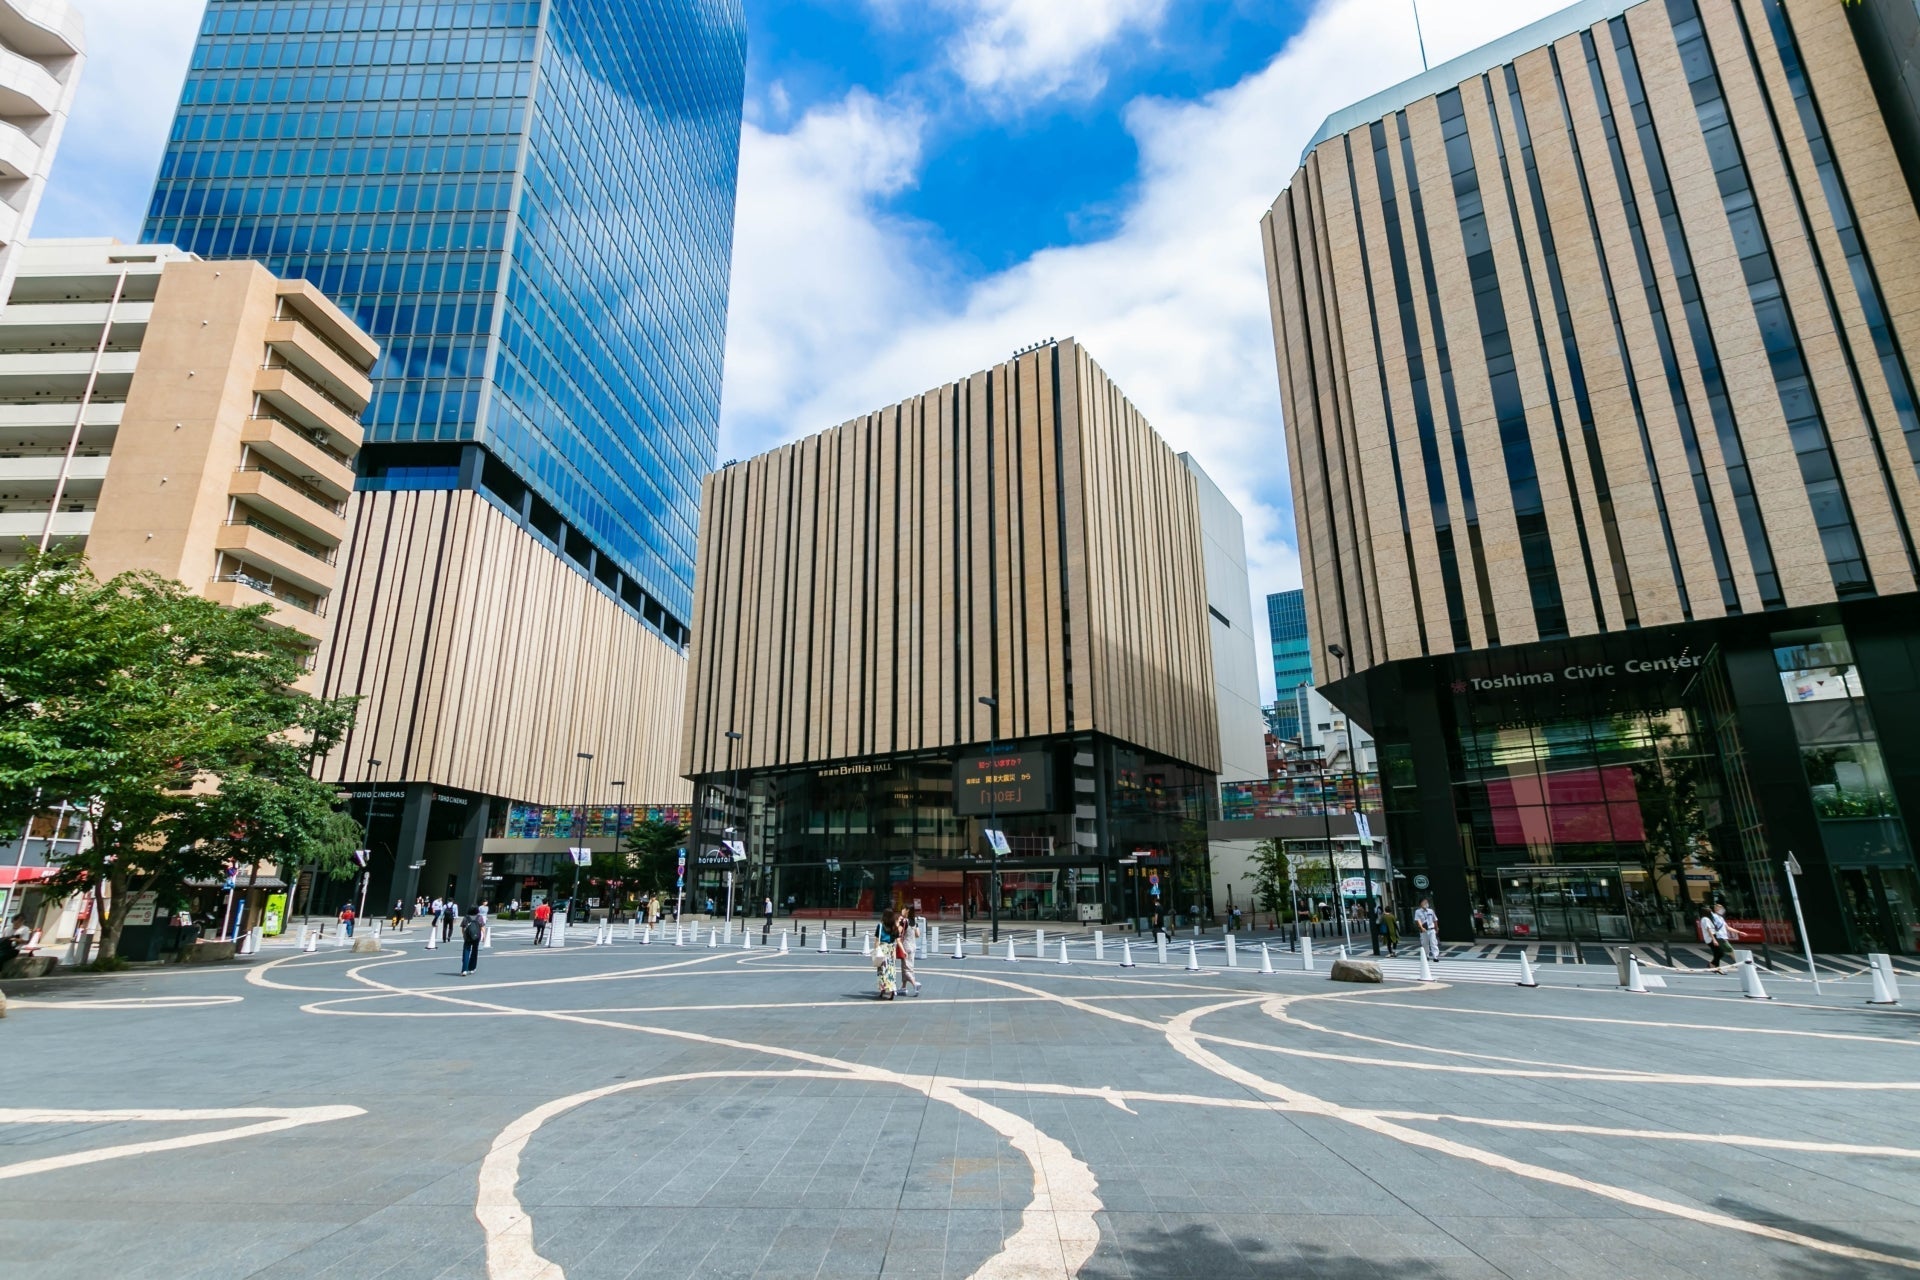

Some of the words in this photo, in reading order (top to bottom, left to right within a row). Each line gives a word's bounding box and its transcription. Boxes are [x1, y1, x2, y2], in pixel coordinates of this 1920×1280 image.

[1471, 672, 1554, 691] Toshima
[1563, 663, 1616, 681] Civic
[1624, 655, 1702, 674] Center
[840, 764, 872, 776] Brillia
[872, 763, 893, 773] HALL
